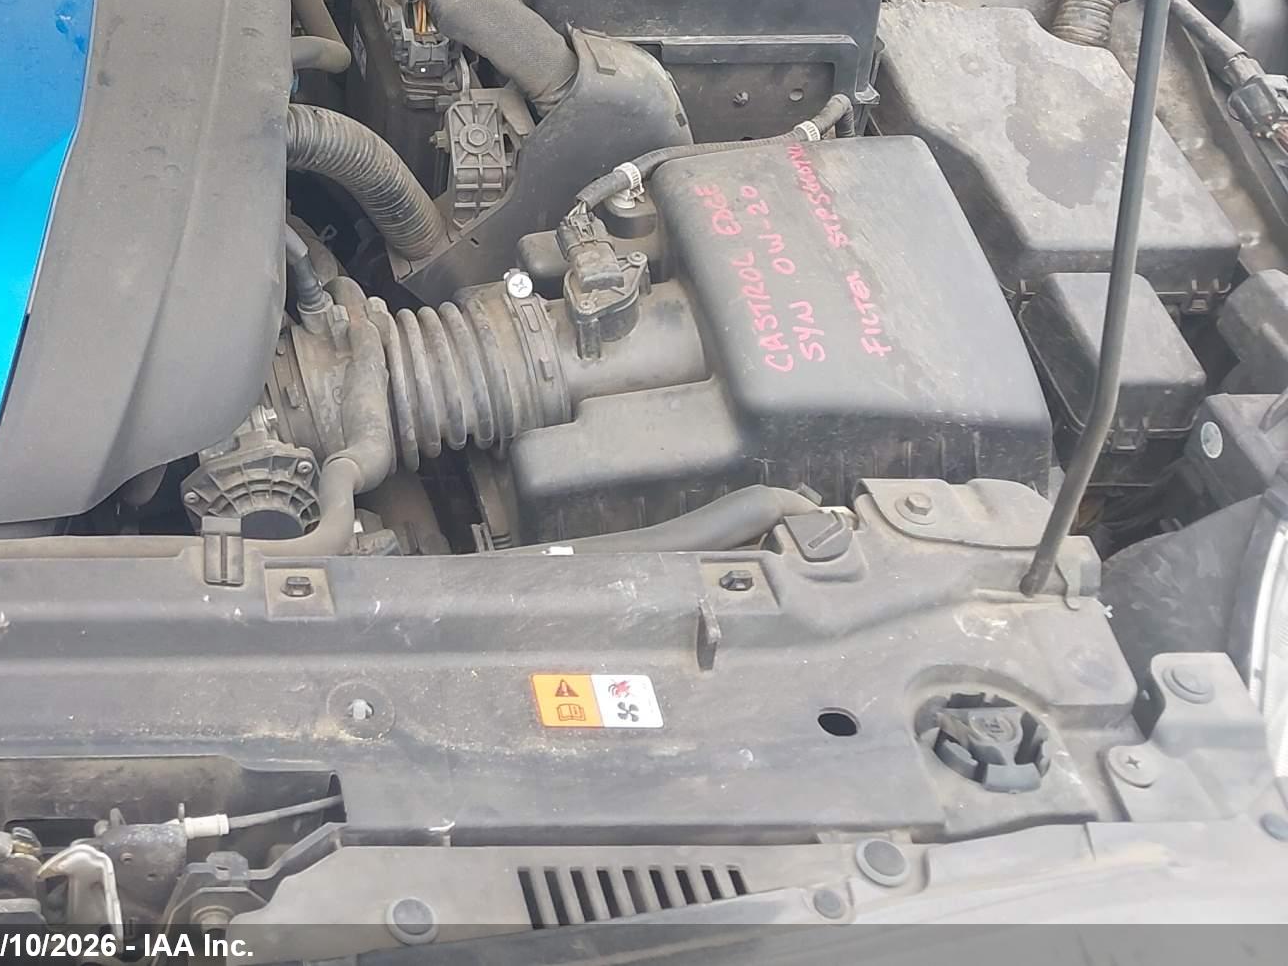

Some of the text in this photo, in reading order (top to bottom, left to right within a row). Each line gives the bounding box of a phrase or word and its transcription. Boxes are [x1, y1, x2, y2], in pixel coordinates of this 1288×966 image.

[695, 185, 794, 373] CASTROL EDGE
[789, 300, 827, 362] SYN
